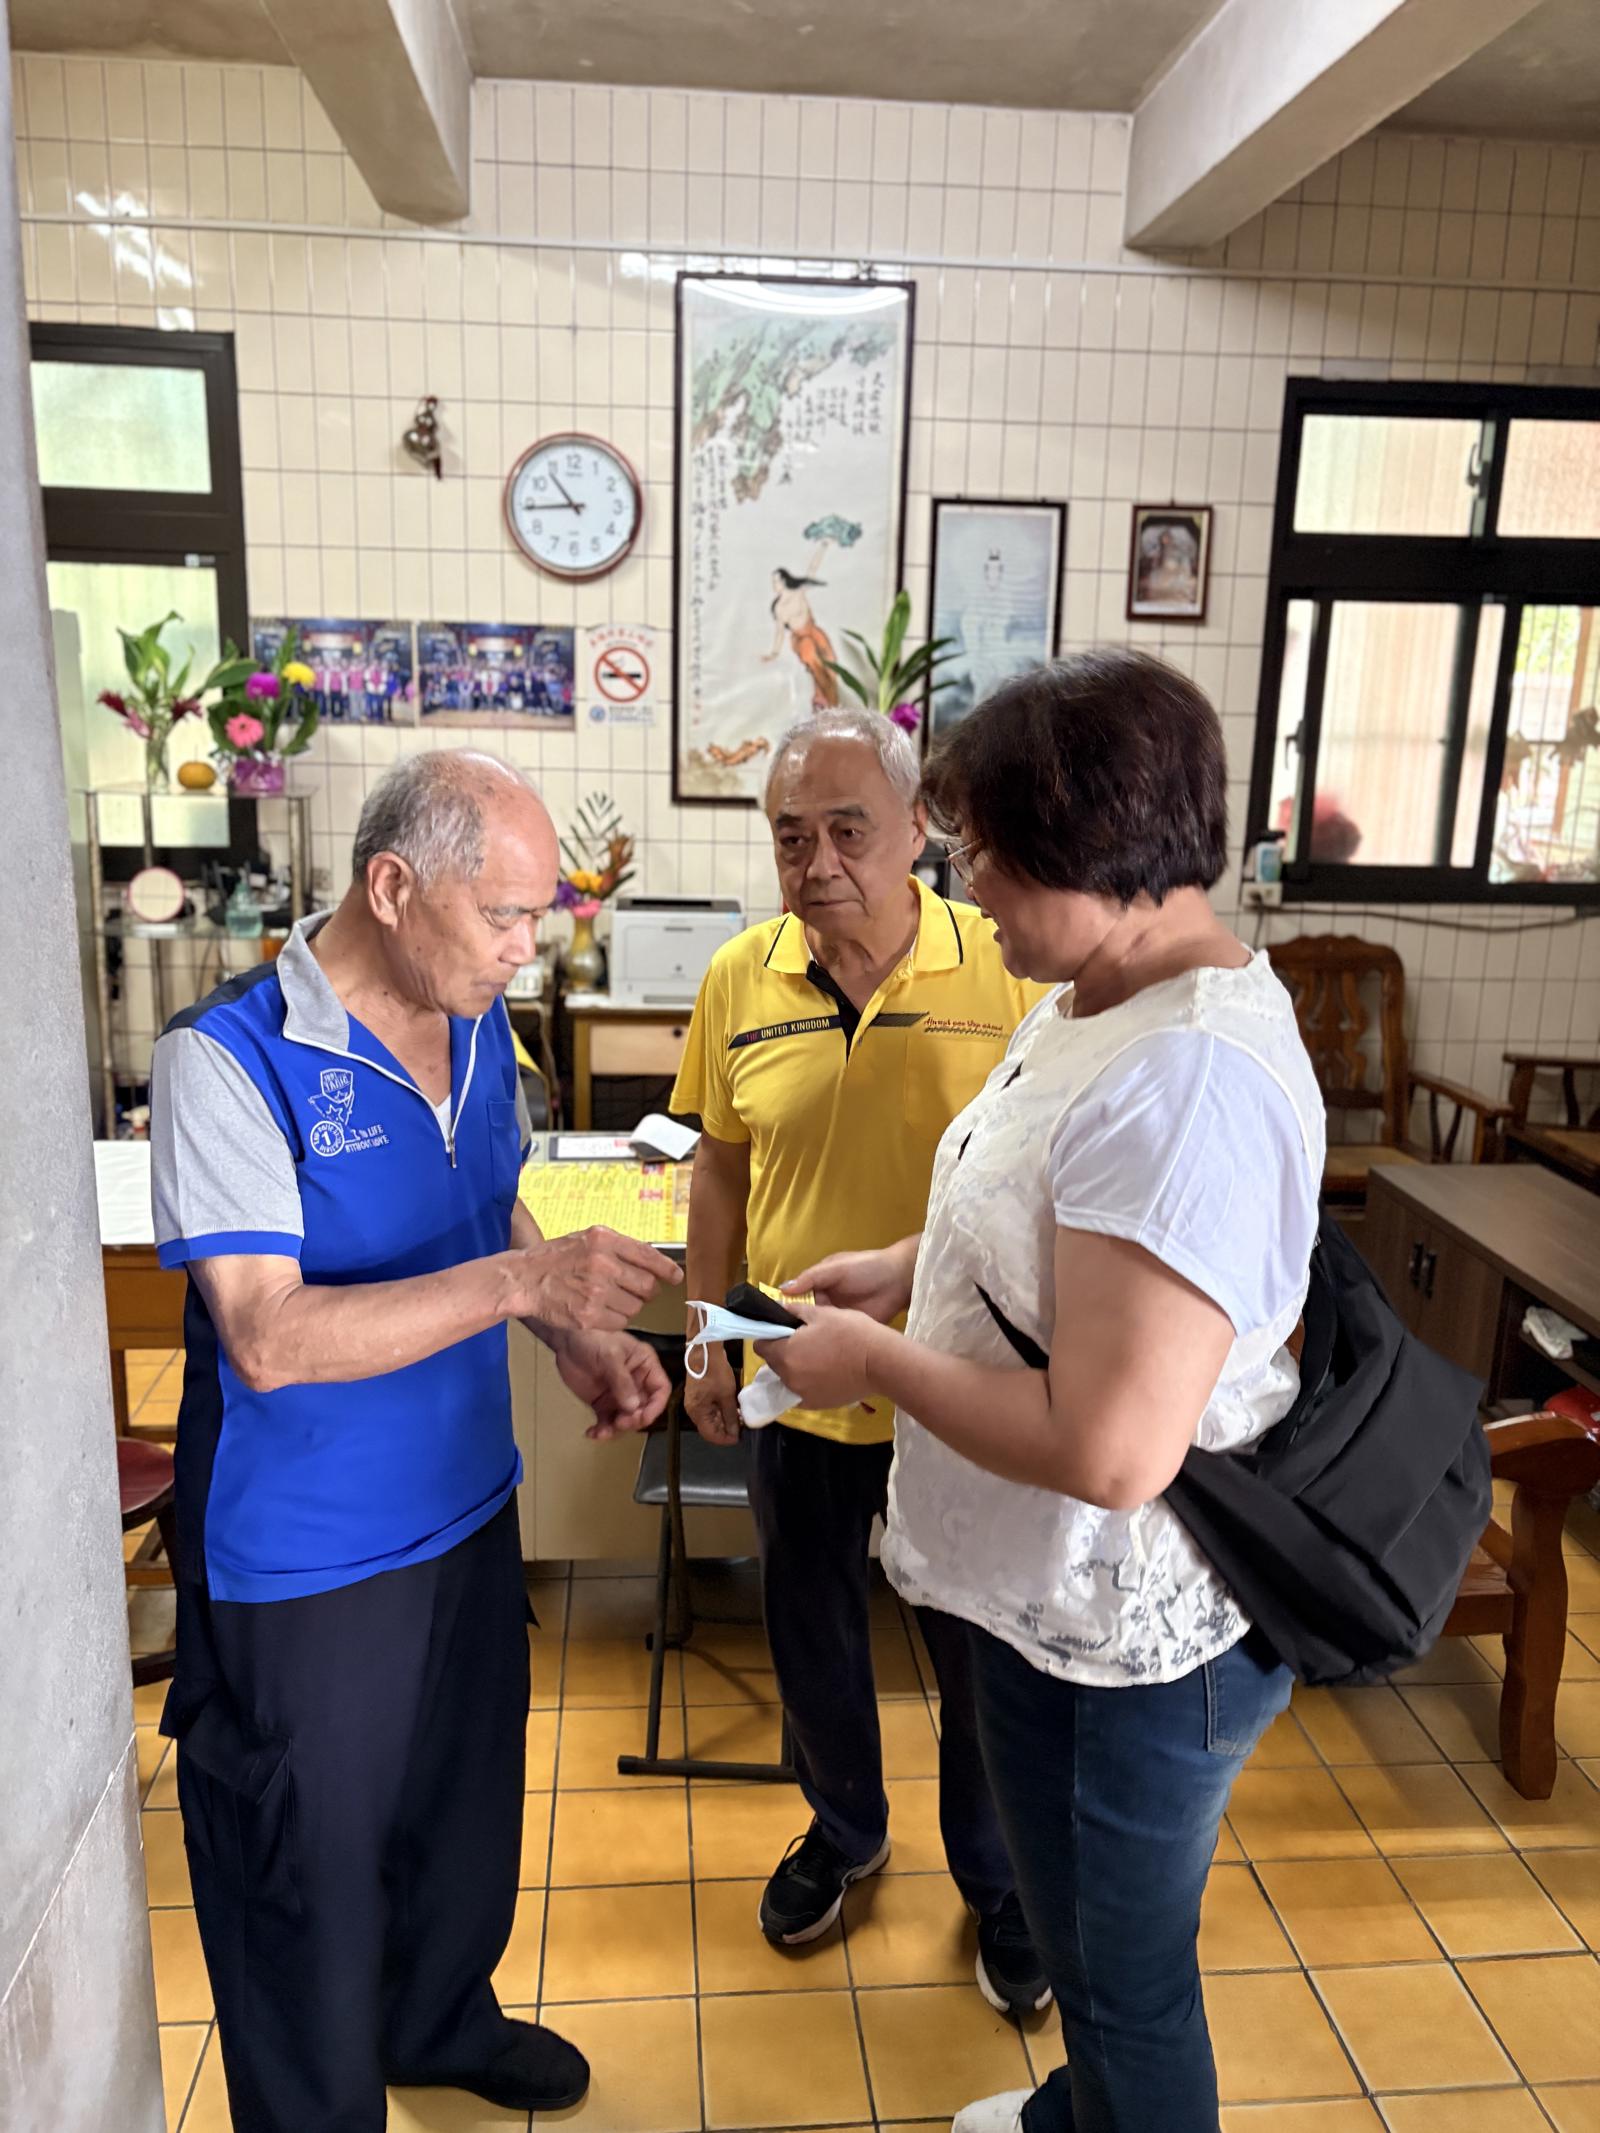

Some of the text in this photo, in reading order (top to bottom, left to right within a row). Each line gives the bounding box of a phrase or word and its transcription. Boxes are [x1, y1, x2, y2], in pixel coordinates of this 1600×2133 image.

[566, 454, 582, 470] 12
[593, 461, 599, 476] 1
[532, 476, 548, 492] 10
[606, 476, 617, 493] 2
[613, 499, 623, 516] 3
[532, 518, 543, 535] 8
[605, 521, 616, 536] 4
[550, 535, 560, 550] 7
[569, 541, 579, 557] 6
[591, 537, 601, 553] 5
[761, 1024, 788, 1039] UNITED
[791, 1018, 830, 1033] KINGDOM
[321, 1130, 332, 1146] 1
